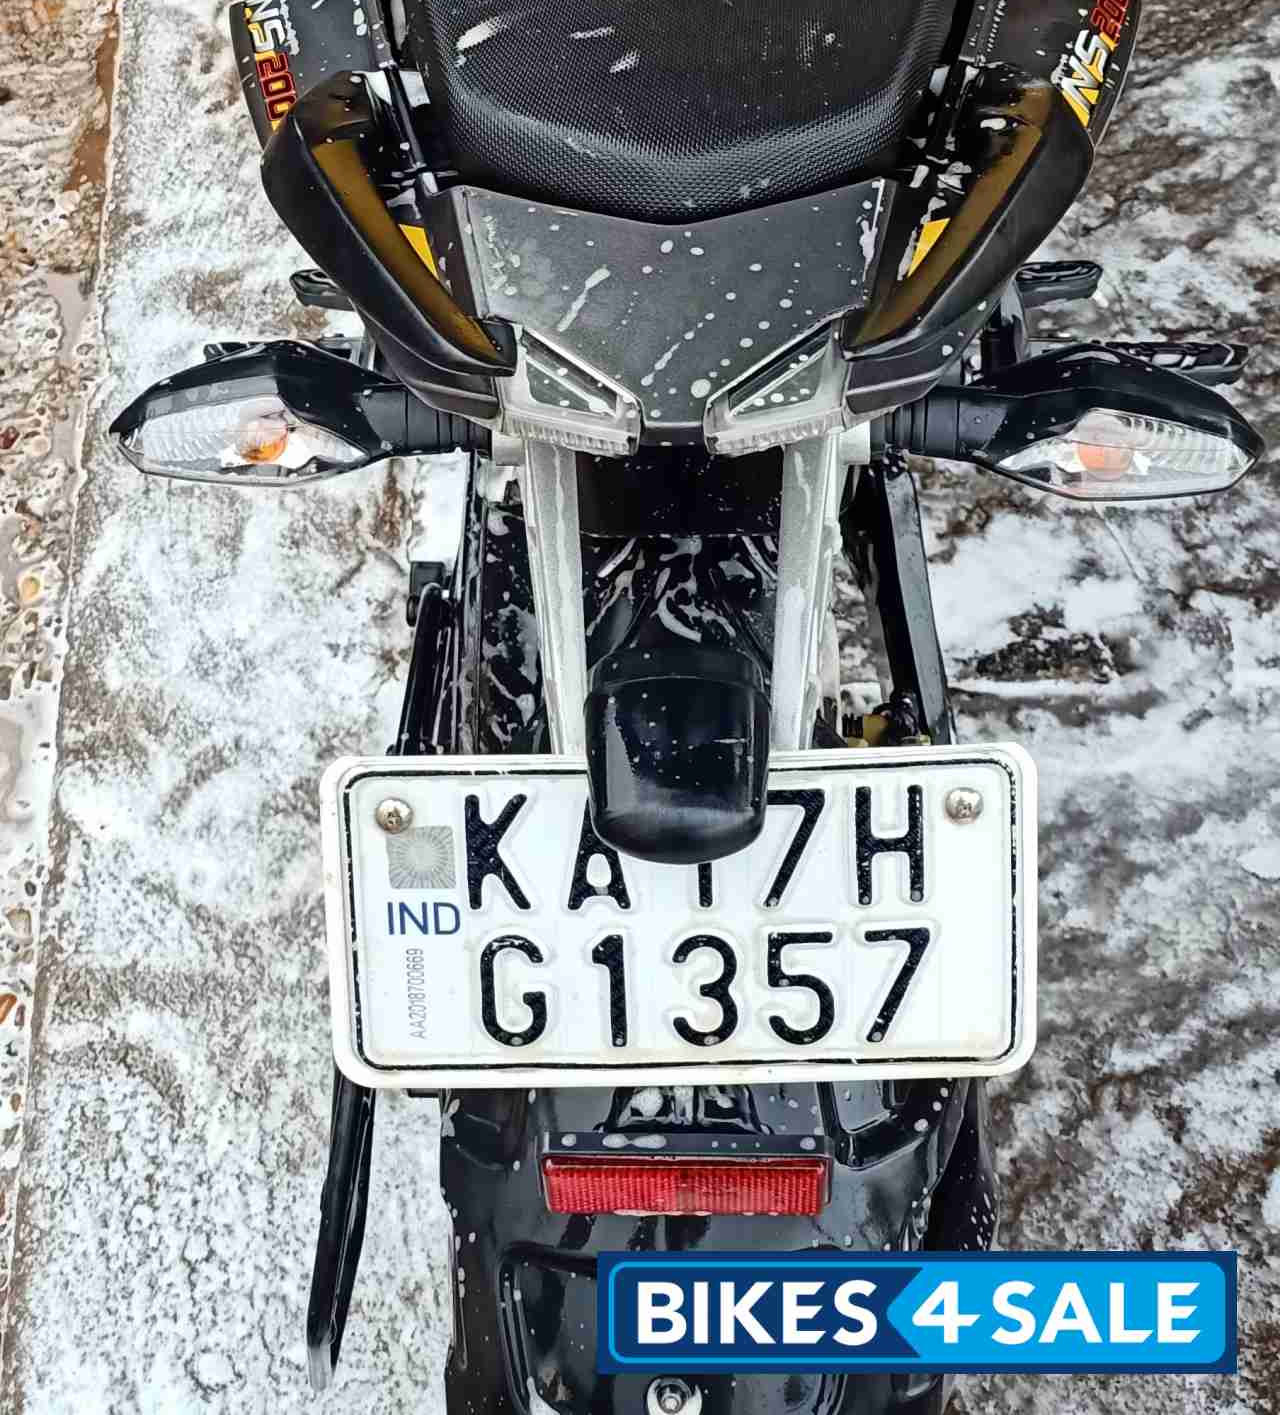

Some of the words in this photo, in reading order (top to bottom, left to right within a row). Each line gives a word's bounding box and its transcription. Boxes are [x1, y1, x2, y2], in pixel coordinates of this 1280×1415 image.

[387, 901, 461, 935] IND
[406, 947, 426, 1040] AA2018700669
[480, 927, 930, 1046] G1357
